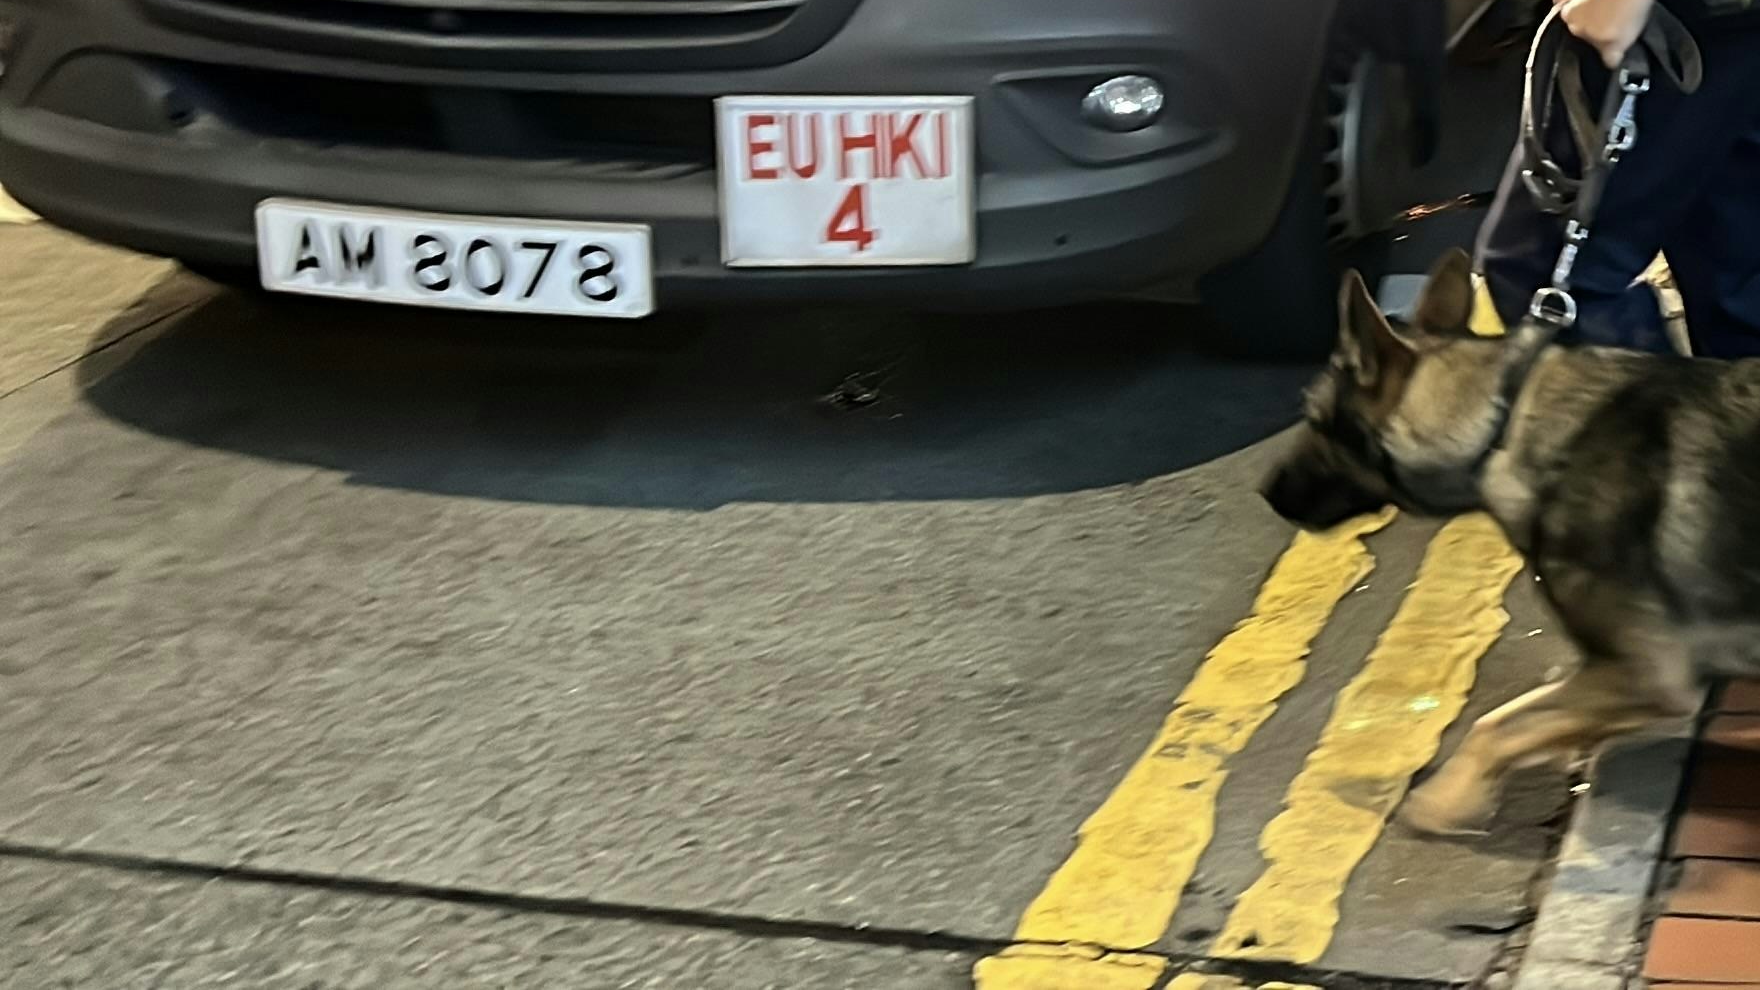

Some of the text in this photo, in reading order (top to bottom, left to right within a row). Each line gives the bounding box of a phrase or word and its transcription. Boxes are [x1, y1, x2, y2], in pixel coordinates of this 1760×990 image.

[742, 112, 822, 180] EU
[821, 182, 880, 252] 4
[293, 219, 619, 302] AM 8078
